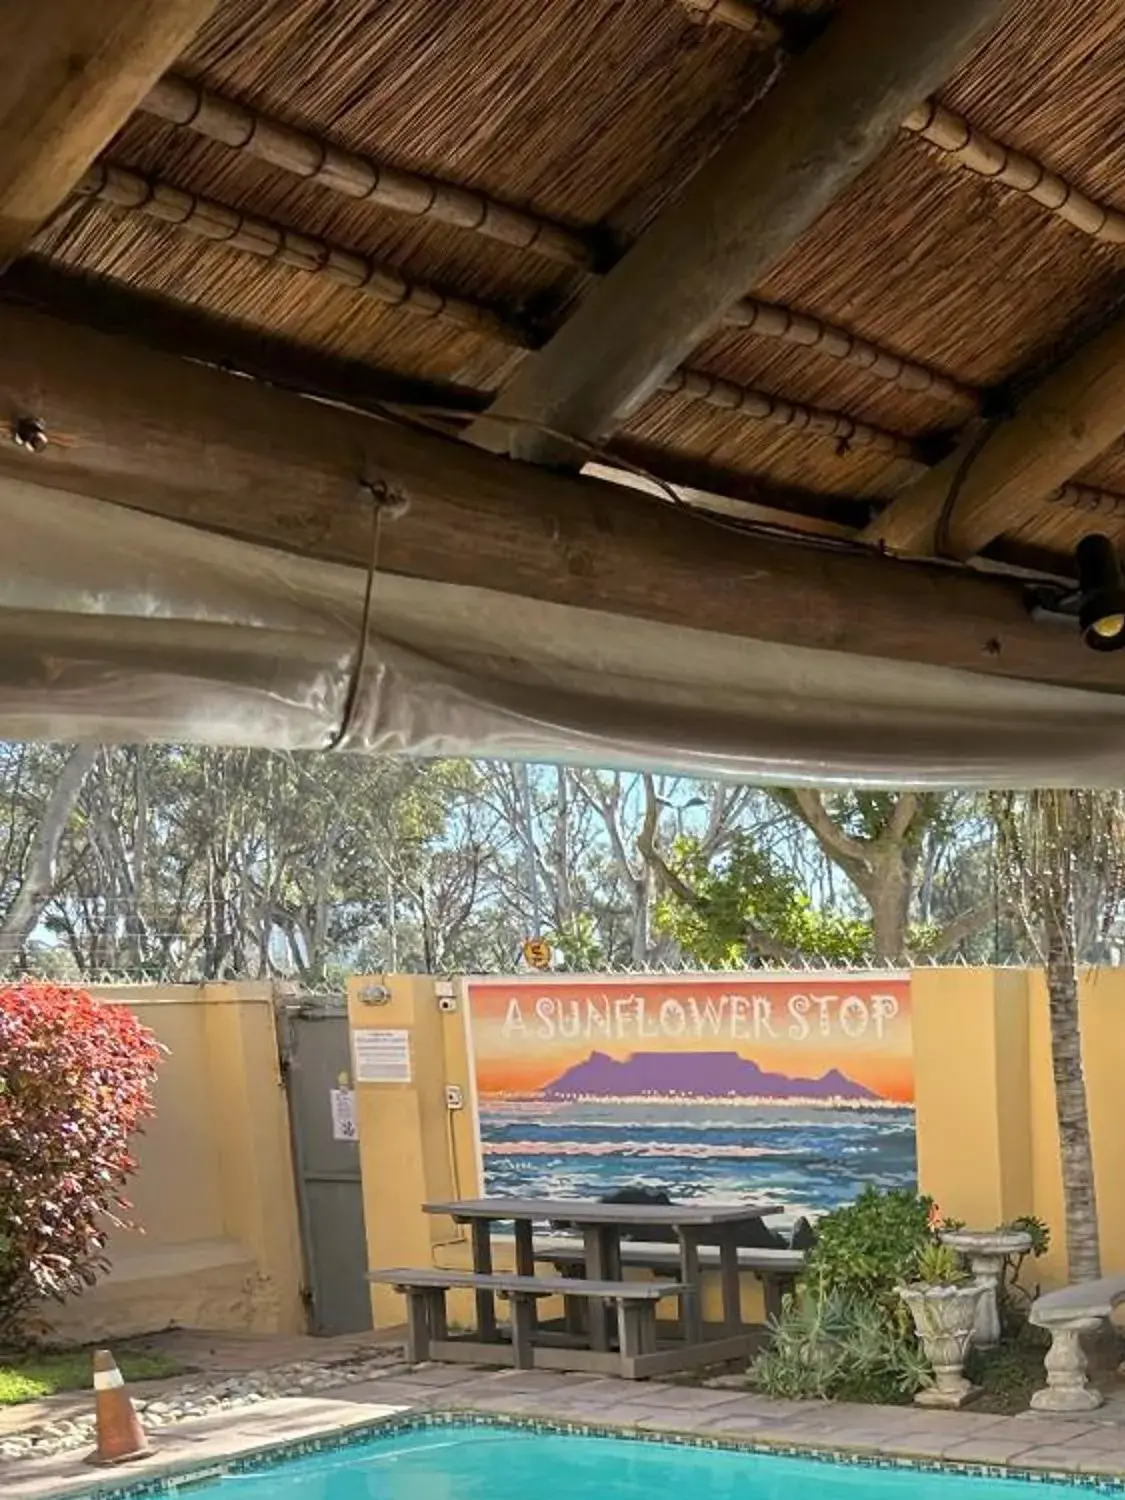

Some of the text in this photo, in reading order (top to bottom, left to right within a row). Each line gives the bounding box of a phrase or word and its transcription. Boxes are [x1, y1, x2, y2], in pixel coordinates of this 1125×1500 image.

[501, 994, 899, 1040] A SUNFLOWER STOP
